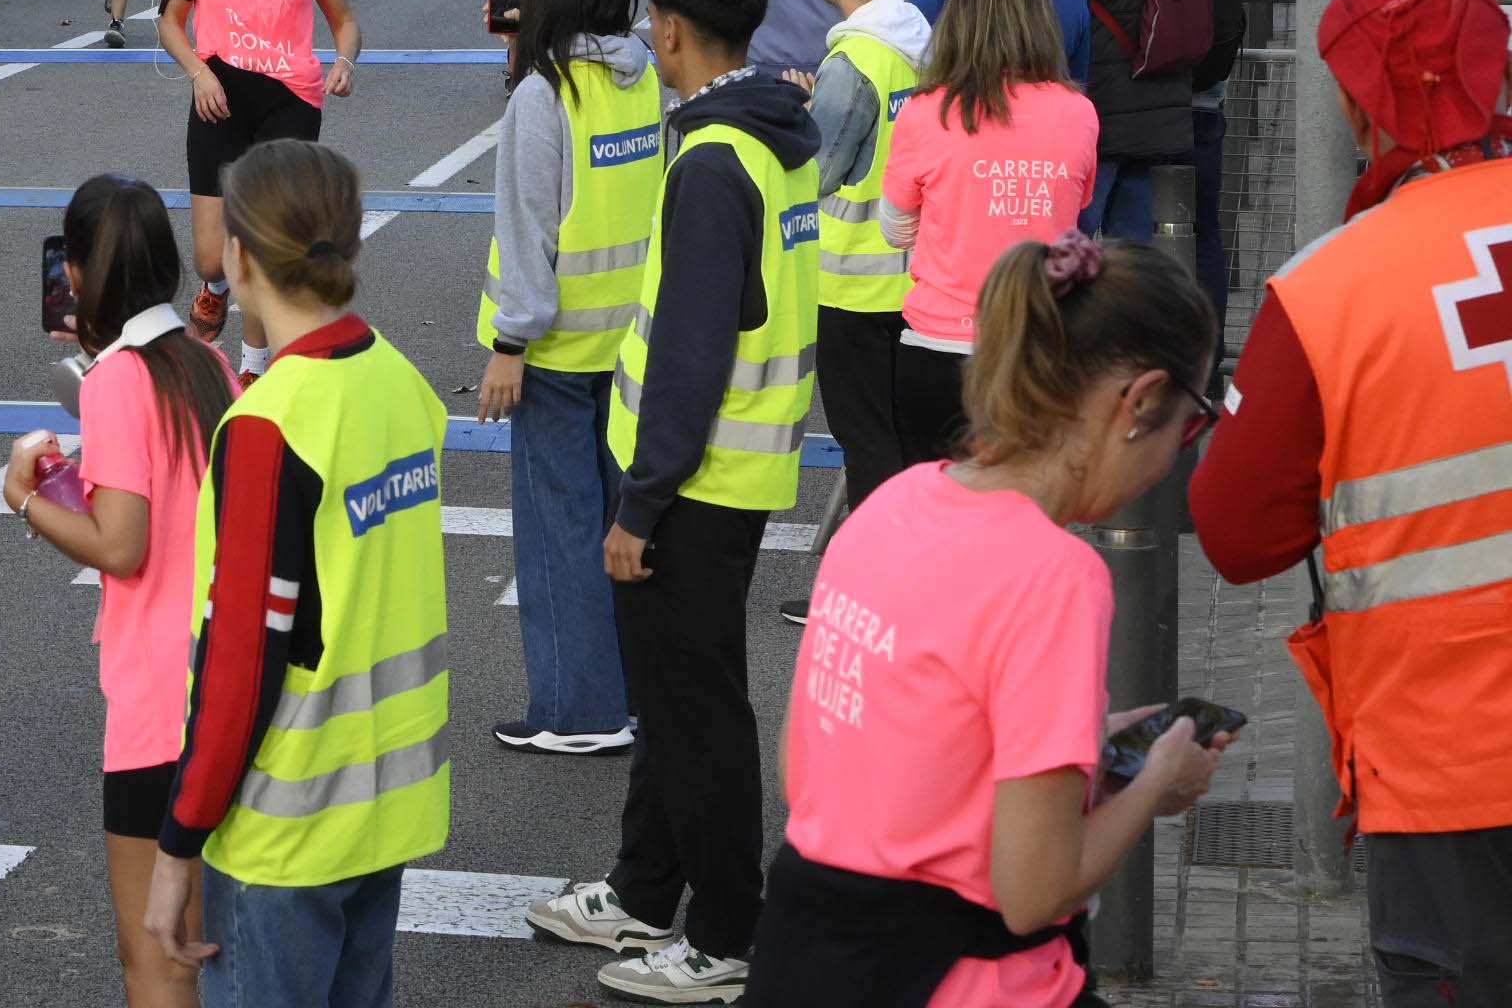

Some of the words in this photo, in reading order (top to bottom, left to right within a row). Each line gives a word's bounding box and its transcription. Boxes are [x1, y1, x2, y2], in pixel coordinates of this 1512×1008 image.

[230, 56, 291, 72] SUMA
[973, 160, 1069, 180] CARRERA
[992, 179, 1019, 197] DE
[1026, 179, 1050, 198] LA
[988, 198, 1053, 217] MUJER
[812, 625, 838, 670] DE
[839, 643, 863, 689] LA
